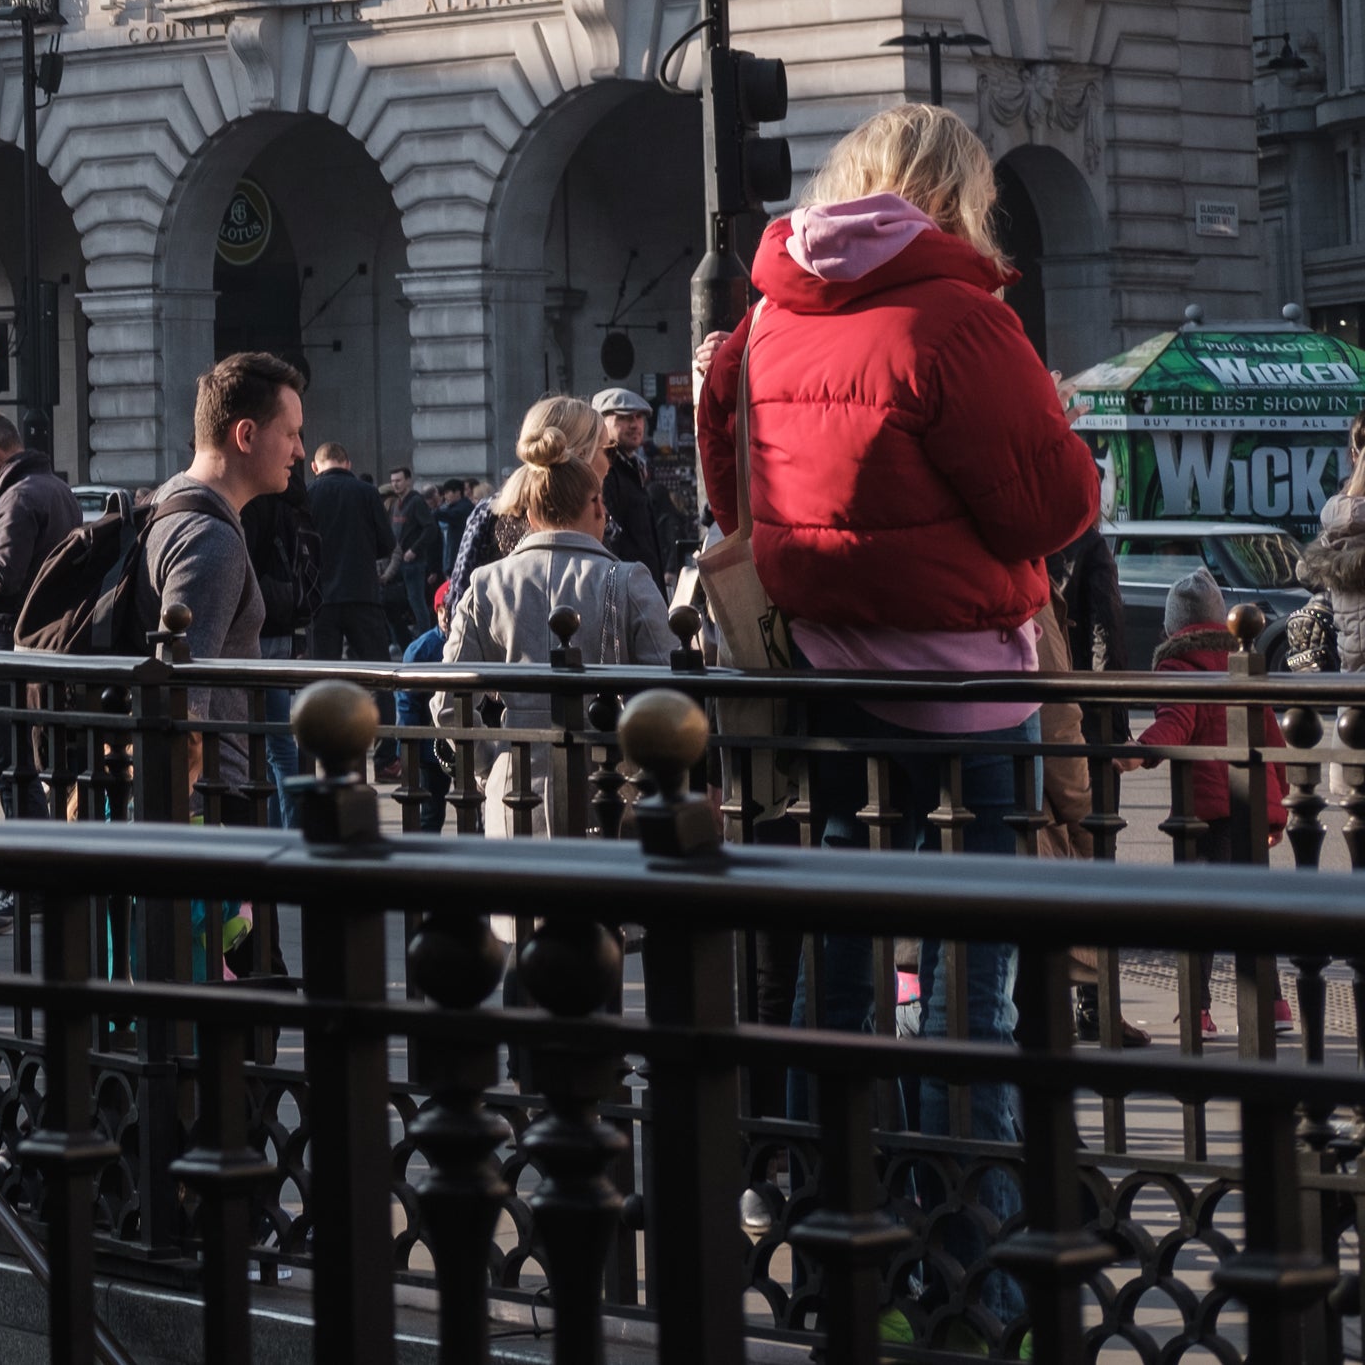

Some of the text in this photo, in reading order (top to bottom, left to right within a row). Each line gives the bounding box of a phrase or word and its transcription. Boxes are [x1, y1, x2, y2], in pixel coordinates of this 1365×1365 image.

[302, 1, 363, 26] FIRE
[220, 221, 262, 241] LOTUS
[1212, 395, 1258, 411] BEST
[1263, 395, 1321, 411] SHOW
[1329, 396, 1349, 411] IN
[1143, 418, 1328, 428] BUY TICKETS FOR ALL
[1149, 433, 1350, 517] WICK
